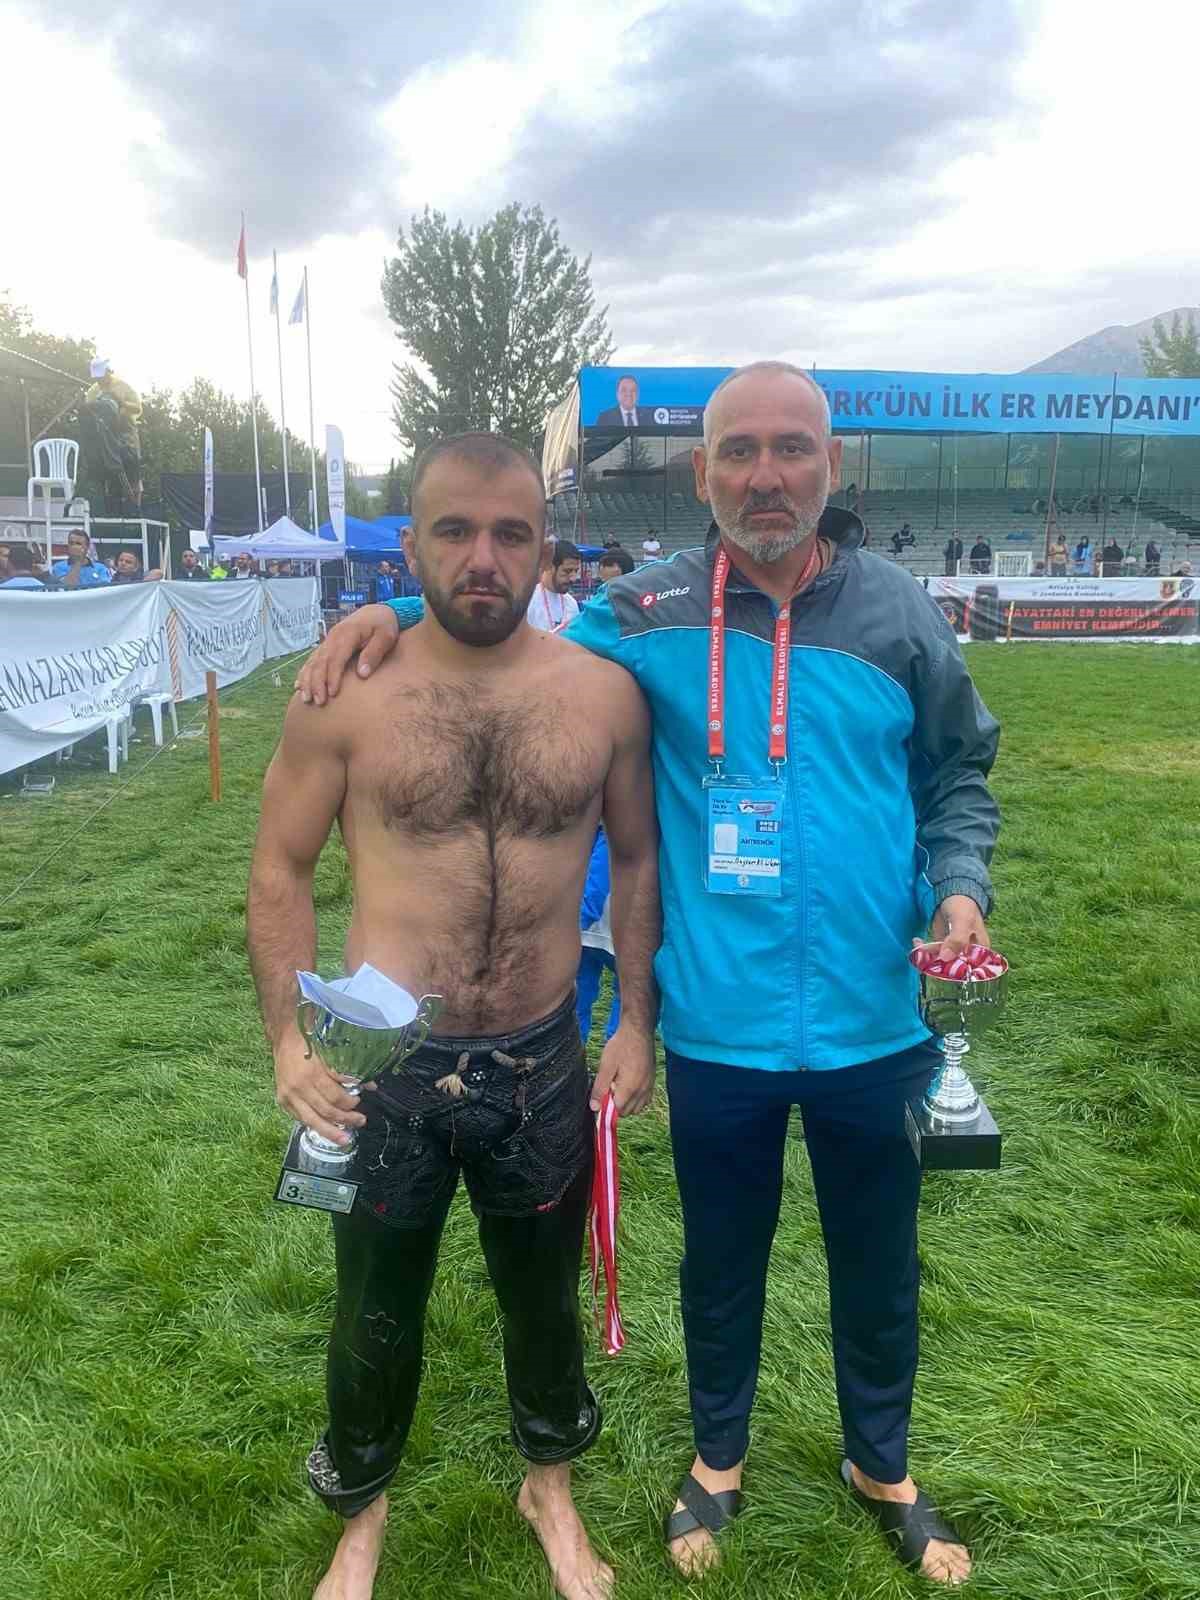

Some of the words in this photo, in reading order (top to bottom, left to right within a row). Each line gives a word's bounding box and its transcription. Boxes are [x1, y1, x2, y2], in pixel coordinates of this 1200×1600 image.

[821, 384, 931, 418] RK'ÜN
[942, 384, 992, 419] İLK
[1000, 392, 1034, 419] ER
[656, 586, 690, 601] lotto
[775, 683, 786, 716] ELMALI
